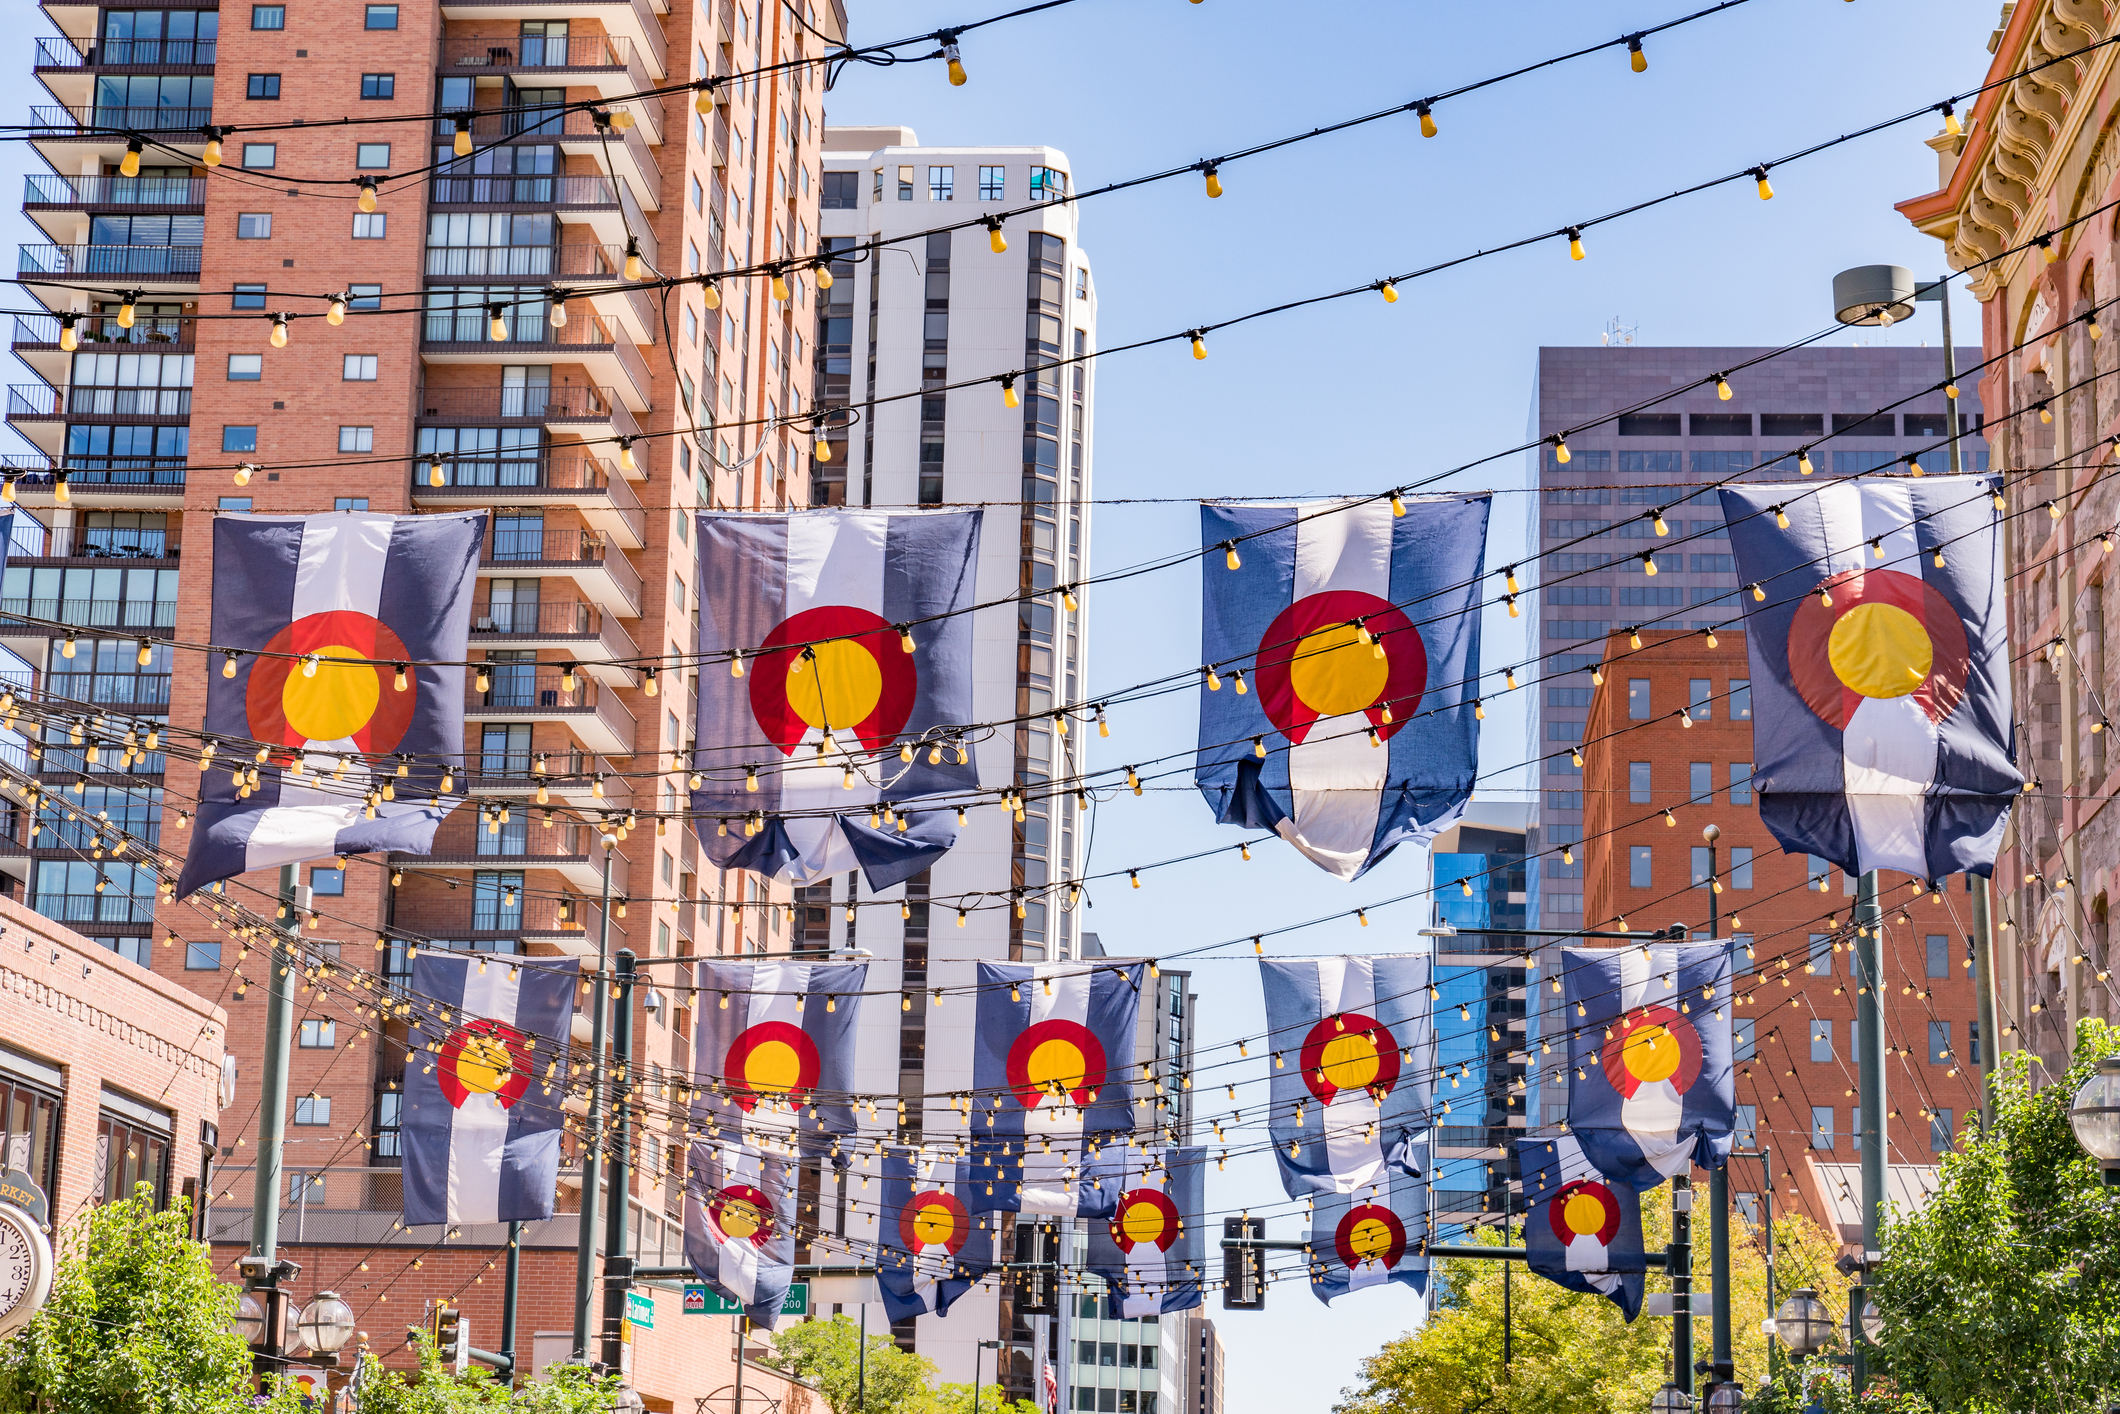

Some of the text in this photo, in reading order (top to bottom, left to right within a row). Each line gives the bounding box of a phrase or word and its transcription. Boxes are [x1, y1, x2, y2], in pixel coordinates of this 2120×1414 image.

[9, 1245, 20, 1259] 2
[11, 1265, 23, 1280] 3
[1, 1287, 13, 1301] 4
[631, 1300, 650, 1324] Larimer
[685, 1301, 704, 1309] DENVER
